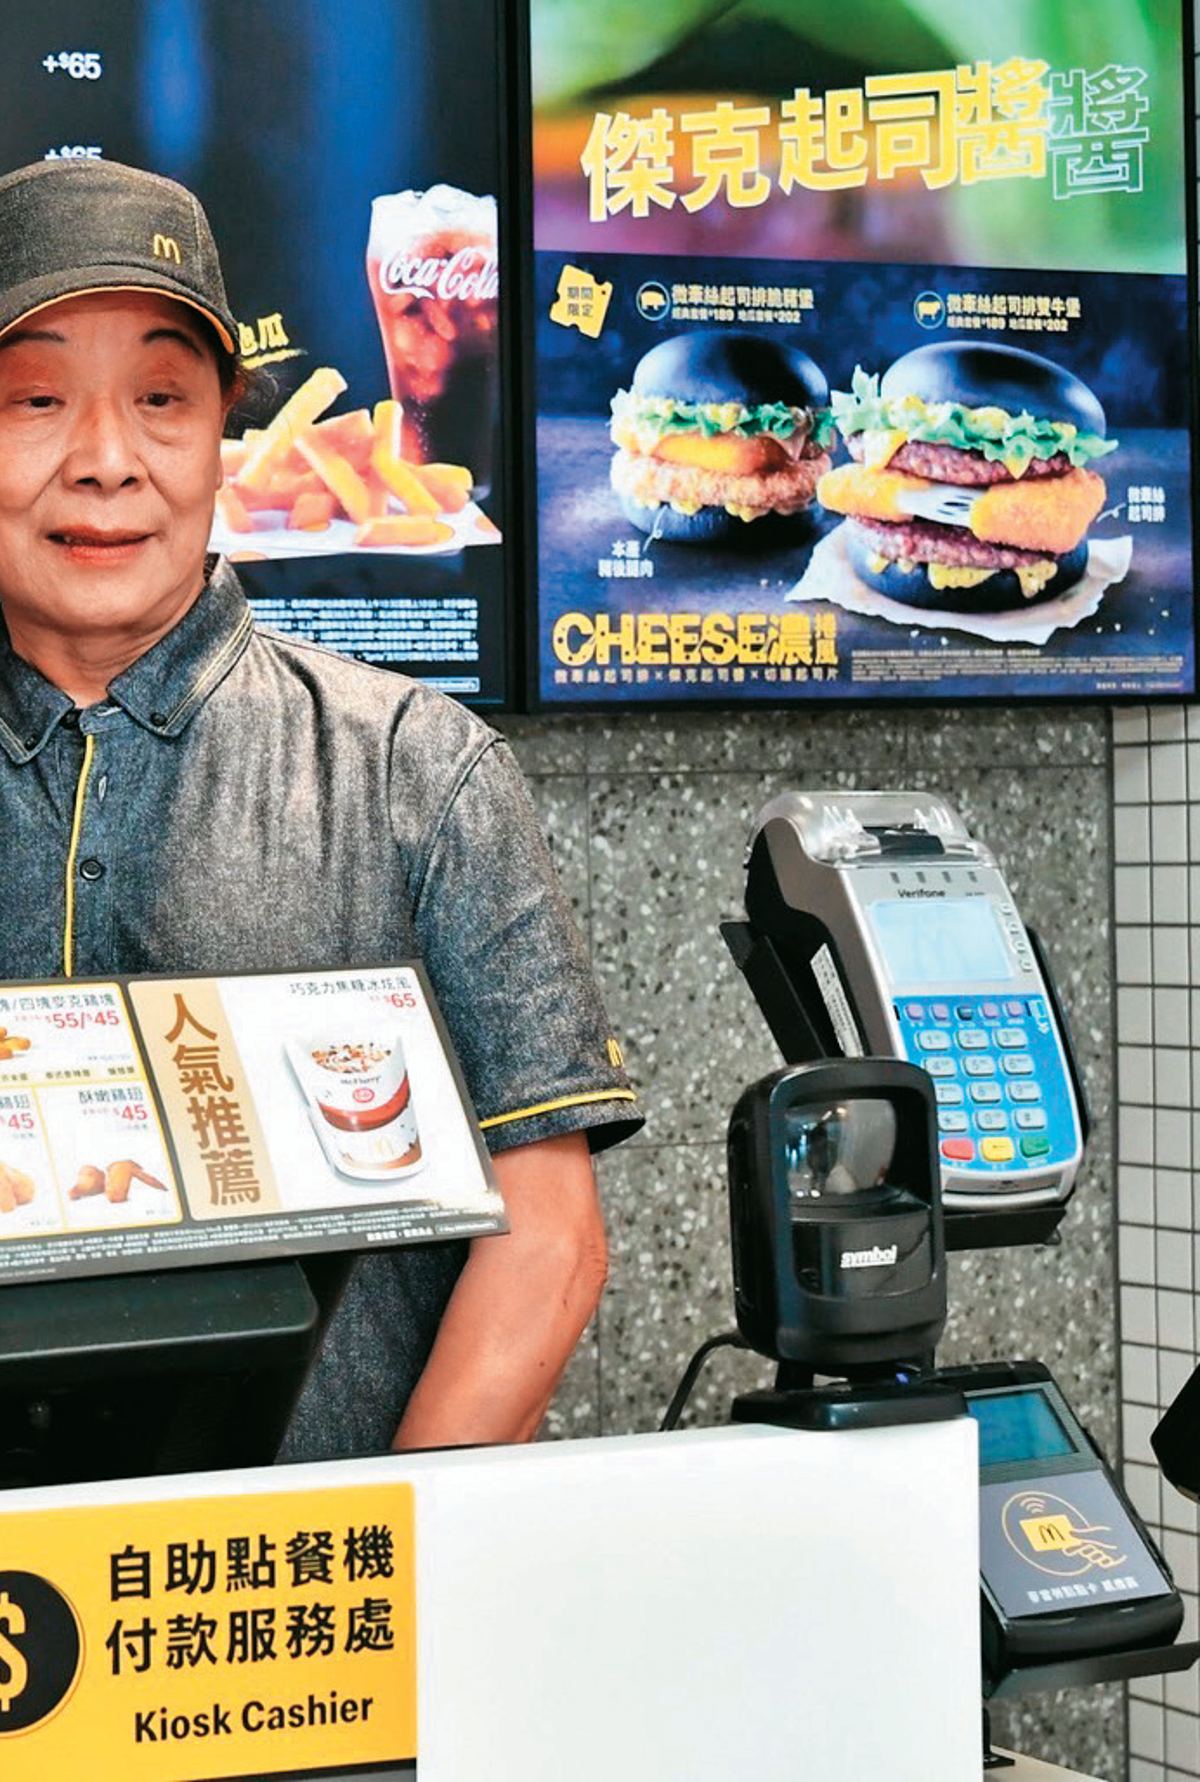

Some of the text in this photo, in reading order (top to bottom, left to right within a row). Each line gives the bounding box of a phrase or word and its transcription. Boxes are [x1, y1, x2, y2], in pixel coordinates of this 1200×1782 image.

[43, 52, 102, 80] +$65
[898, 888, 946, 899] Verifone
[164, 993, 261, 1207] 人氣推薦
[840, 1244, 898, 1269] symbol
[109, 1524, 395, 1602] 自助點餐機
[105, 1597, 395, 1676] 付款服務處
[134, 1690, 374, 1743] Kiosk Cashier
